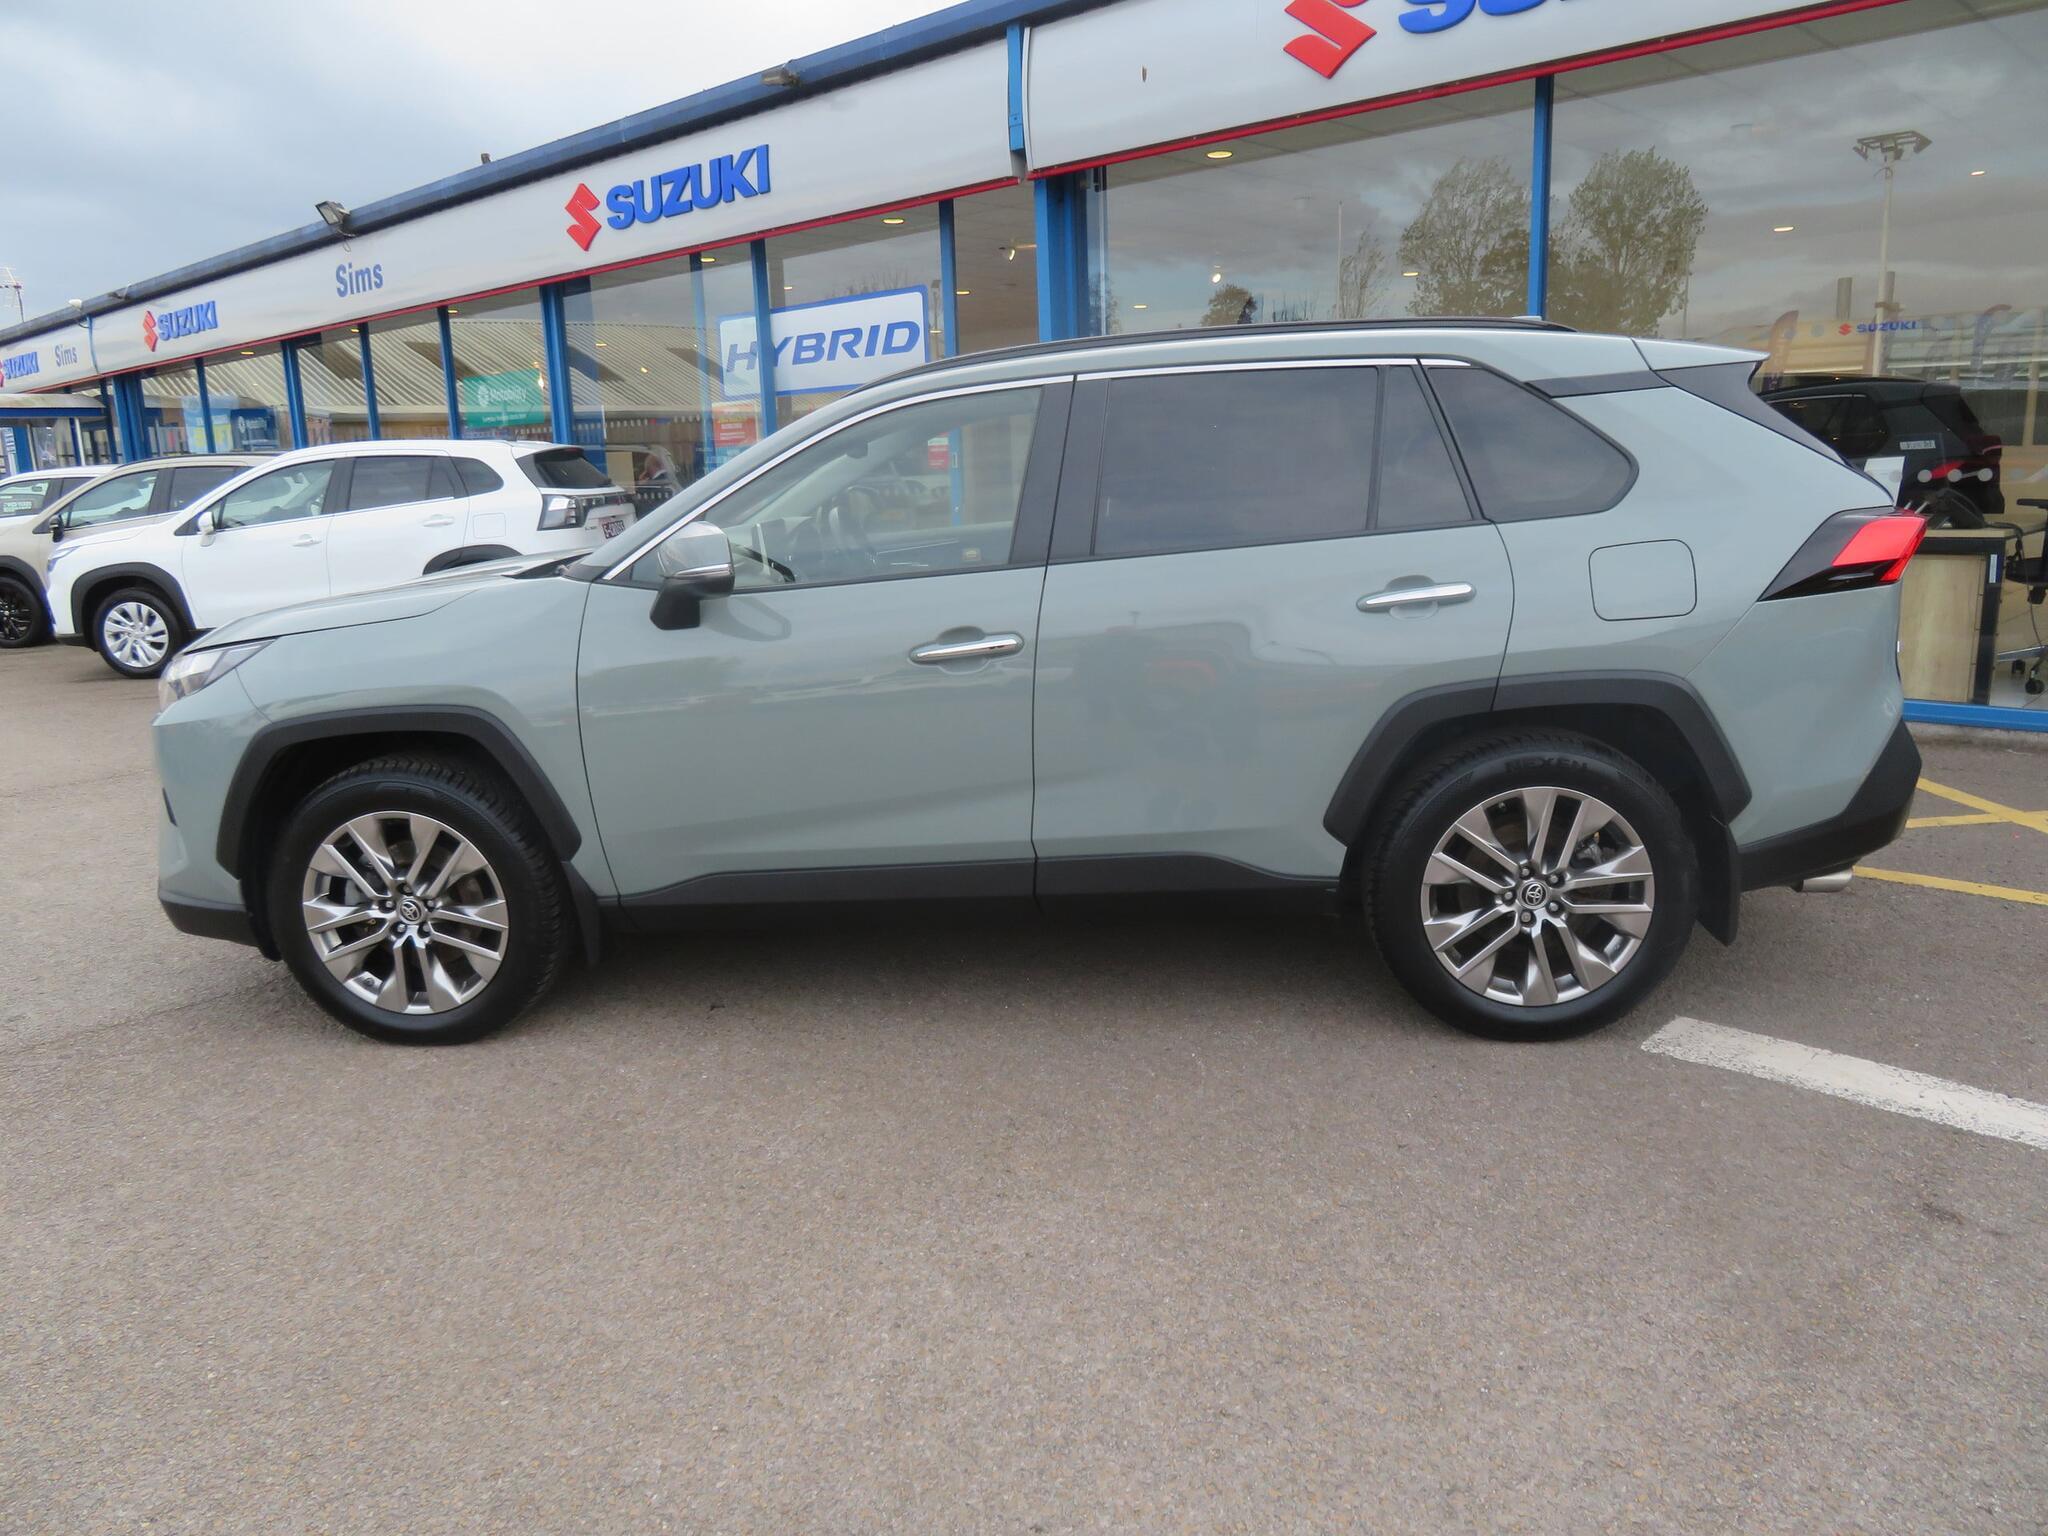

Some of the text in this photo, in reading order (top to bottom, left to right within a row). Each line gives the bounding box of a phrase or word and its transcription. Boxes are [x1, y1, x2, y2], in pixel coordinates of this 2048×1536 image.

[606, 144, 771, 230] SUZUKI
[335, 262, 384, 298] Sims
[157, 300, 218, 342] SUZUKI
[1856, 320, 1918, 333] SUZUKI
[54, 343, 78, 368] Sims
[726, 320, 921, 373] HYBRID
[3, 351, 40, 380] SUZUKI
